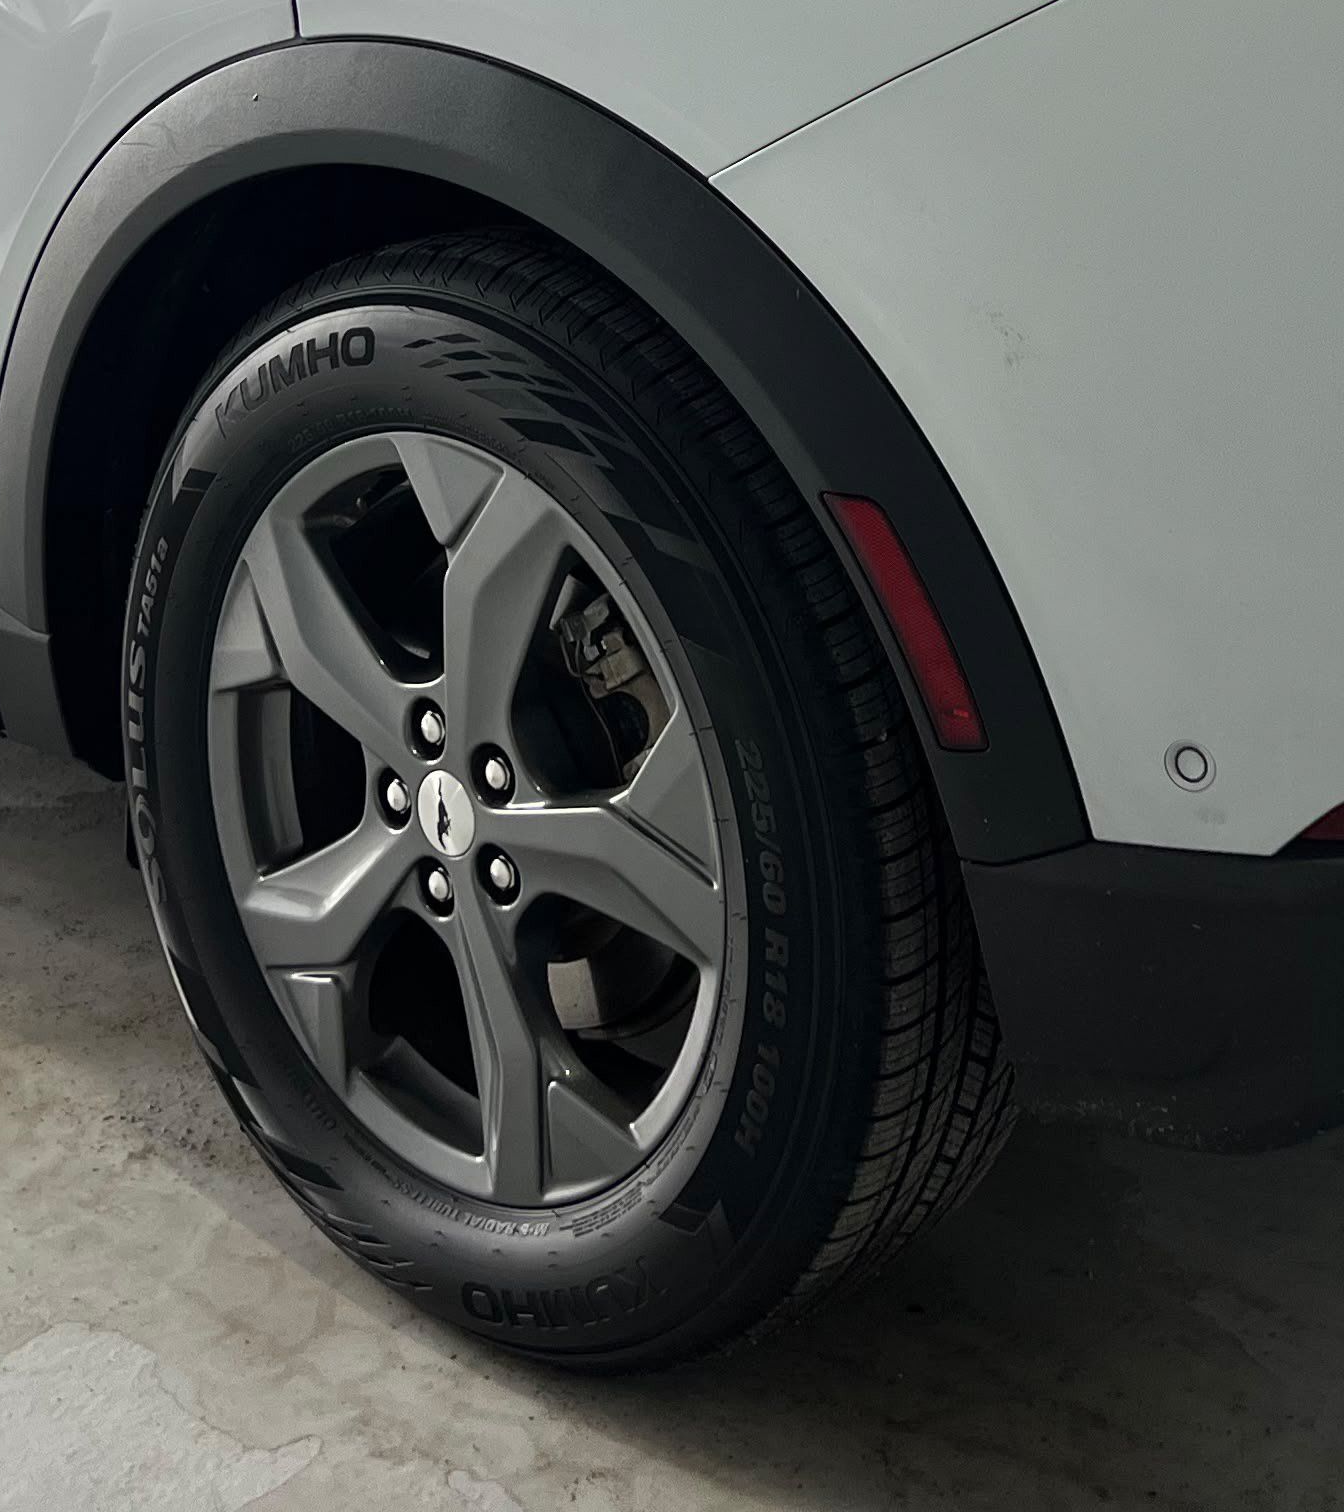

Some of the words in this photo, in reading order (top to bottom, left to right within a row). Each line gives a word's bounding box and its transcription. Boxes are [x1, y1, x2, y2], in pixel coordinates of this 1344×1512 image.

[214, 326, 377, 439] KUMHO
[127, 639, 168, 905] SOLUS
[733, 737, 787, 915] 225/60
[761, 927, 790, 1031] R18
[733, 1043, 781, 1160] 100H
[462, 1212, 517, 1236] RADIAL
[461, 1254, 670, 1332] KUMHO
